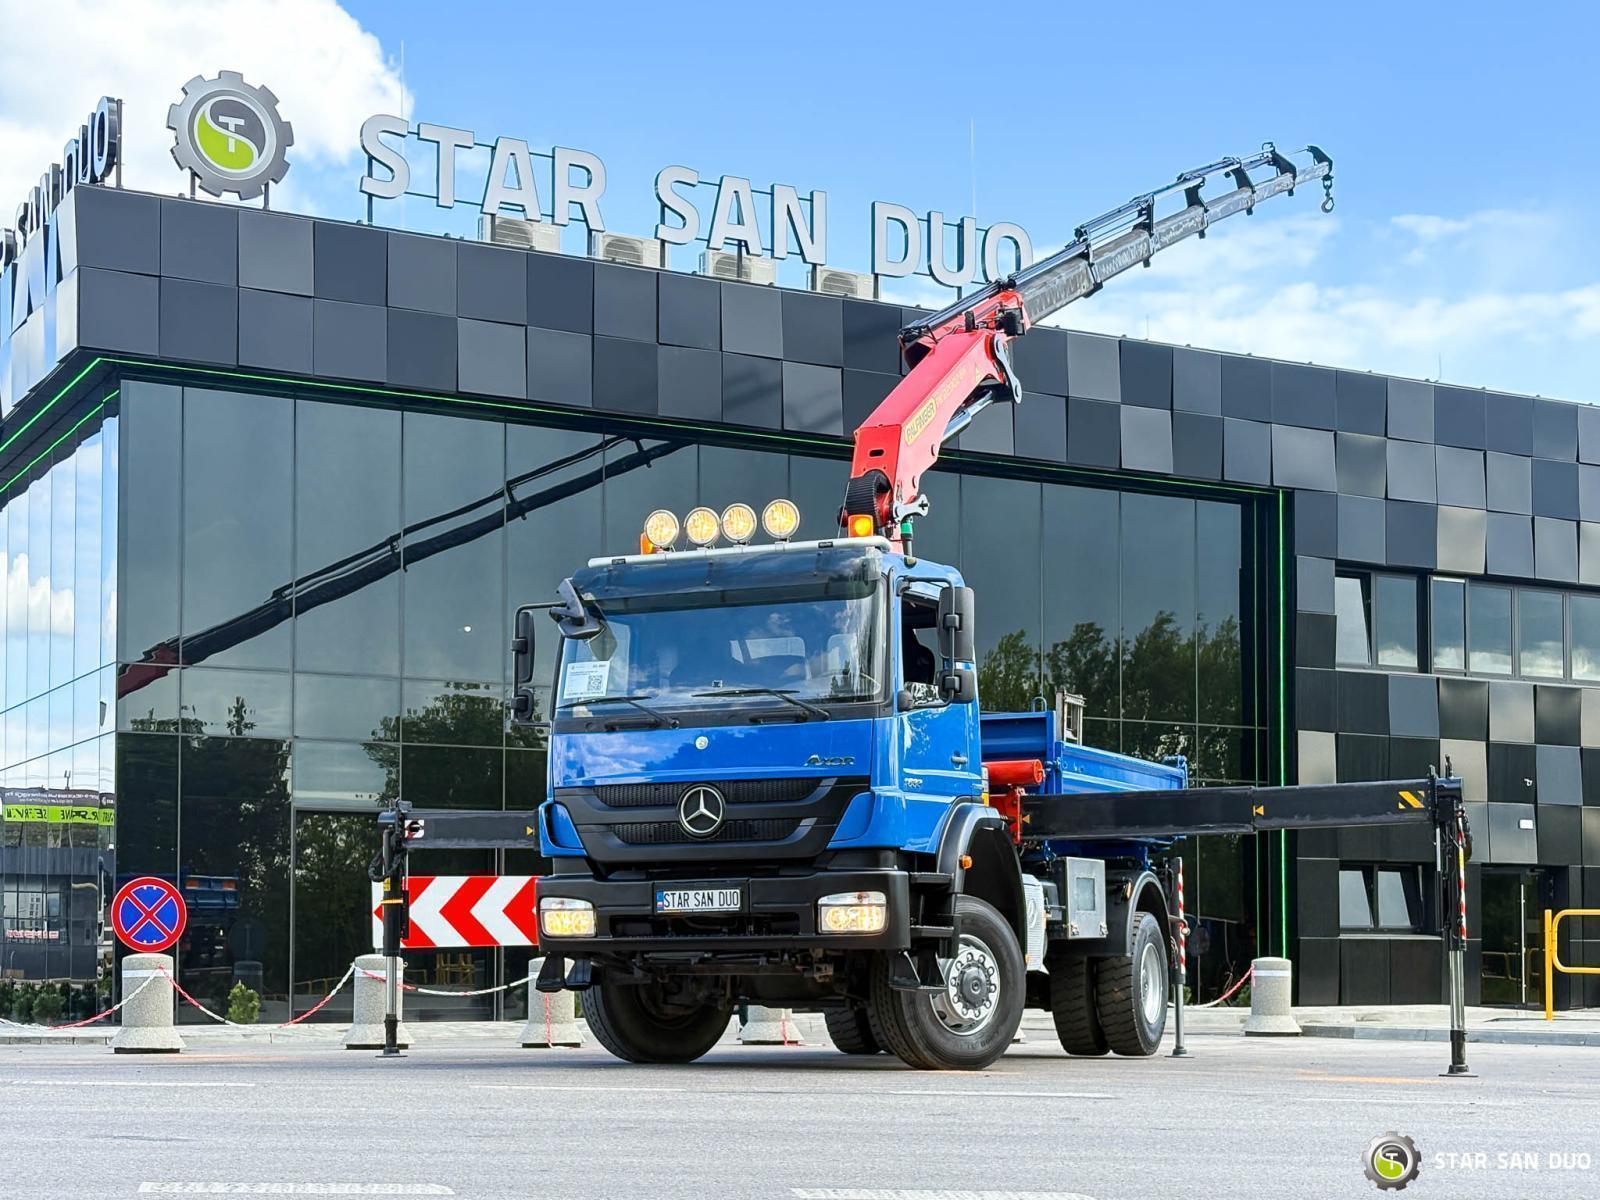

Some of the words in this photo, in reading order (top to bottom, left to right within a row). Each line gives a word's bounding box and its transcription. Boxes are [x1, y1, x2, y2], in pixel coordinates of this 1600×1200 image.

[359, 114, 606, 232] STAR
[654, 165, 827, 265] SAN
[871, 201, 1033, 288] DUO
[663, 893, 689, 908] STAR
[694, 892, 713, 907] SAN
[719, 891, 739, 907] DUO
